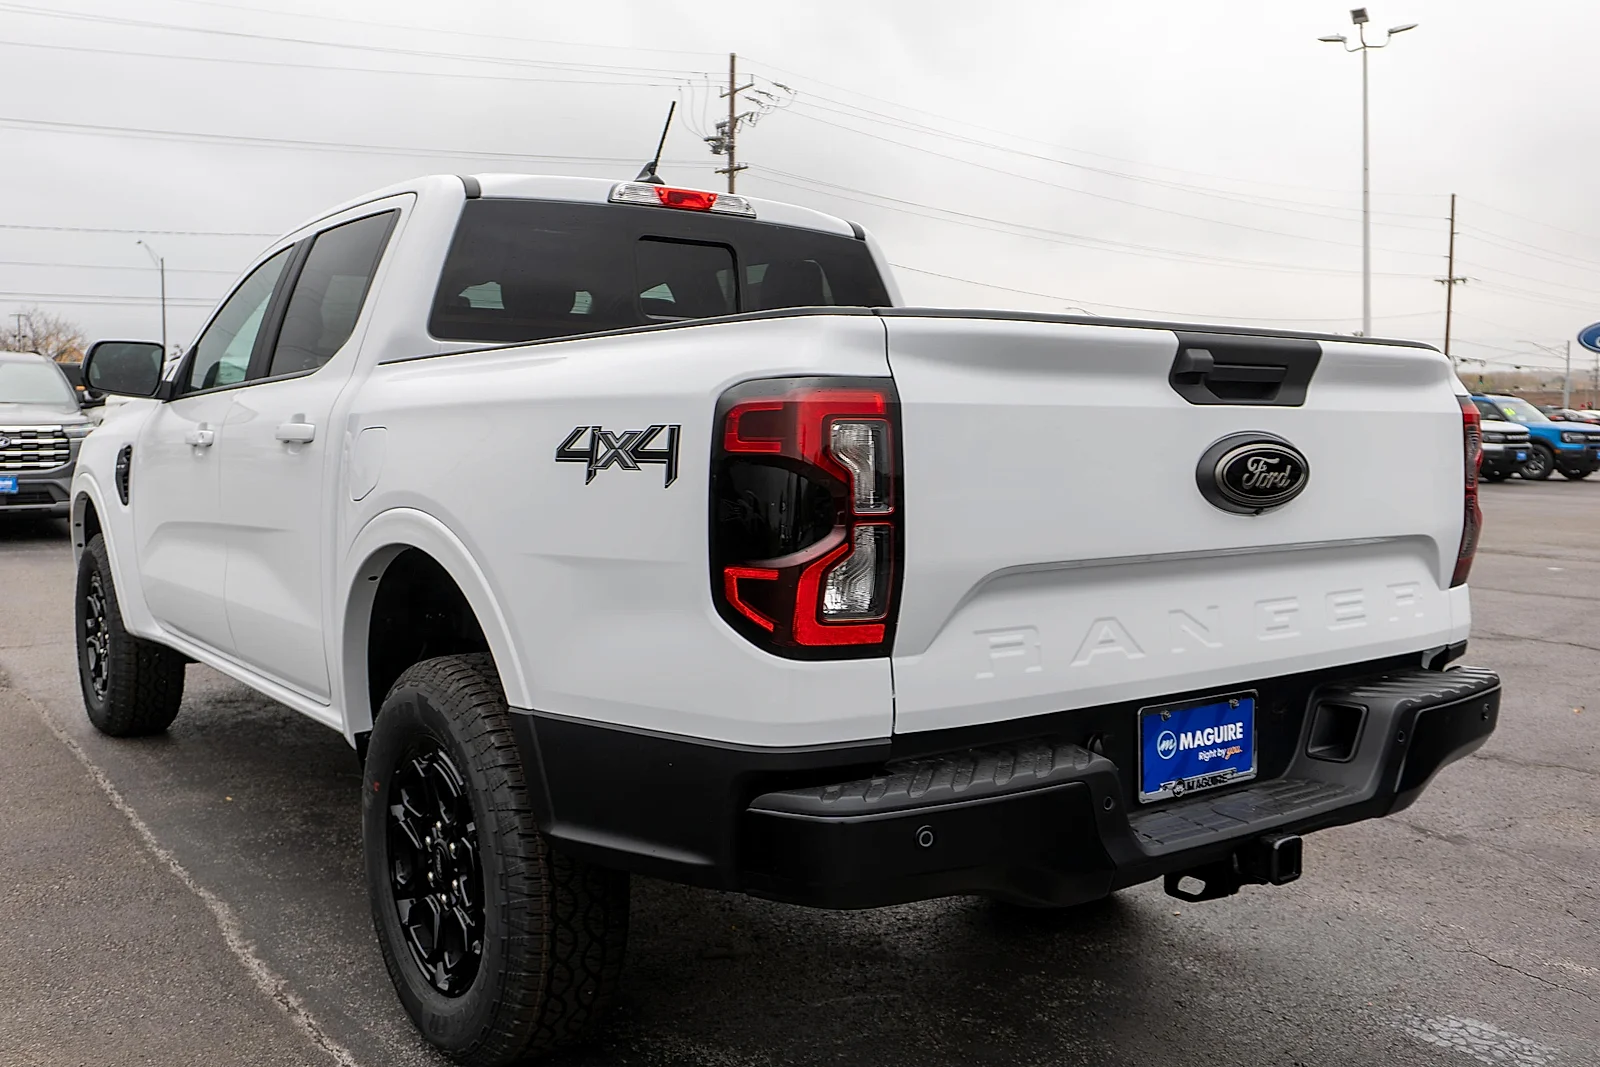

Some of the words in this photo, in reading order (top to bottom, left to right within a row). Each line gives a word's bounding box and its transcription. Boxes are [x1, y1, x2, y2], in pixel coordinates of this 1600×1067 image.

[1242, 456, 1292, 490] Ford
[973, 581, 1425, 680] RANGER
[1179, 722, 1243, 750] MAGUIRE
[1198, 749, 1217, 762] Right
[1217, 747, 1227, 759] by
